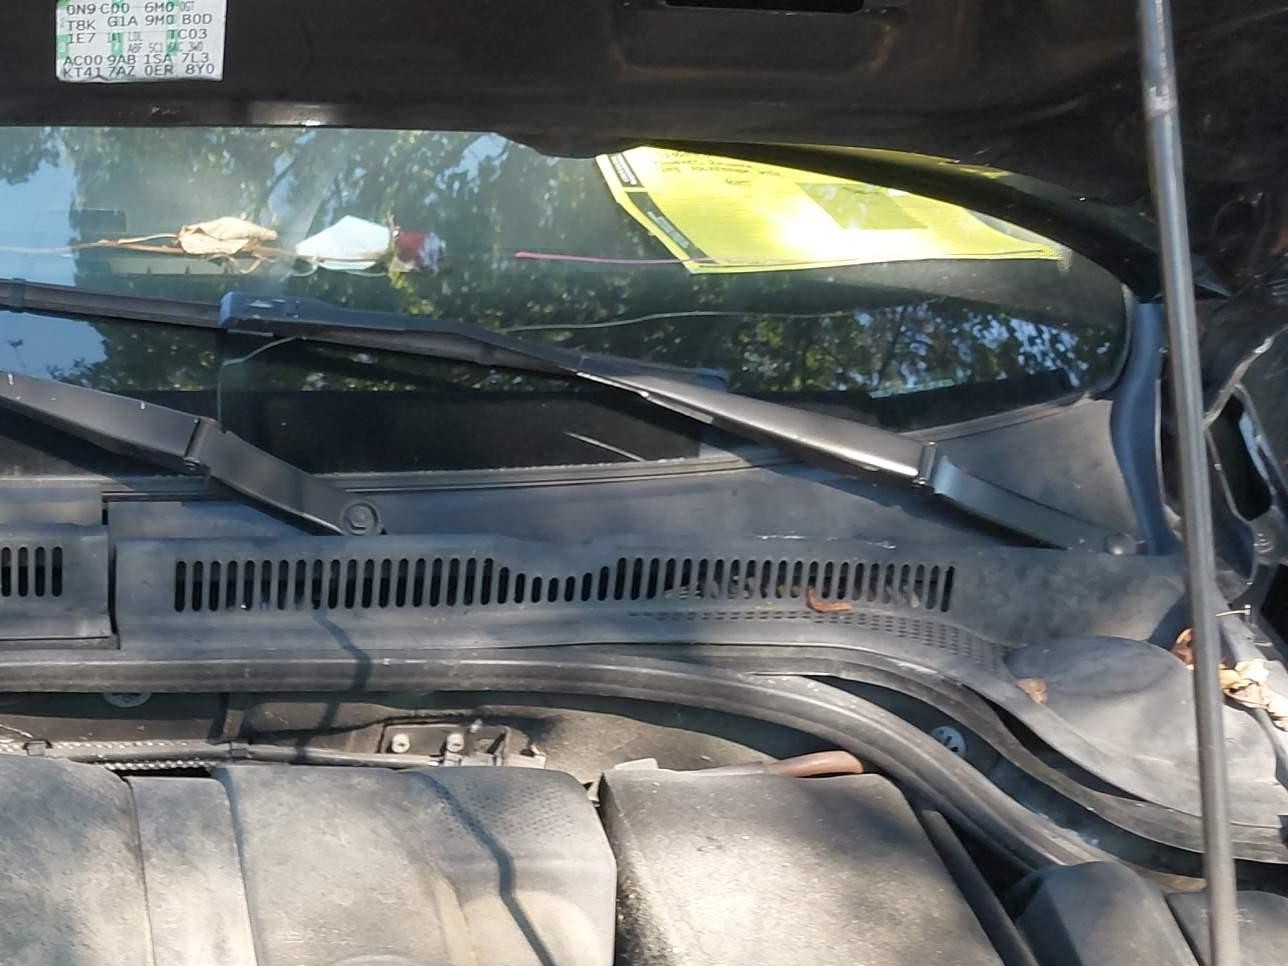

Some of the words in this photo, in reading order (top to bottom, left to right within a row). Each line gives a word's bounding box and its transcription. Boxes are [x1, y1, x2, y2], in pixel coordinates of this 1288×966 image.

[67, 20, 96, 31] T8K
[68, 33, 96, 44] 1E7
[182, 53, 209, 63] 7L3
